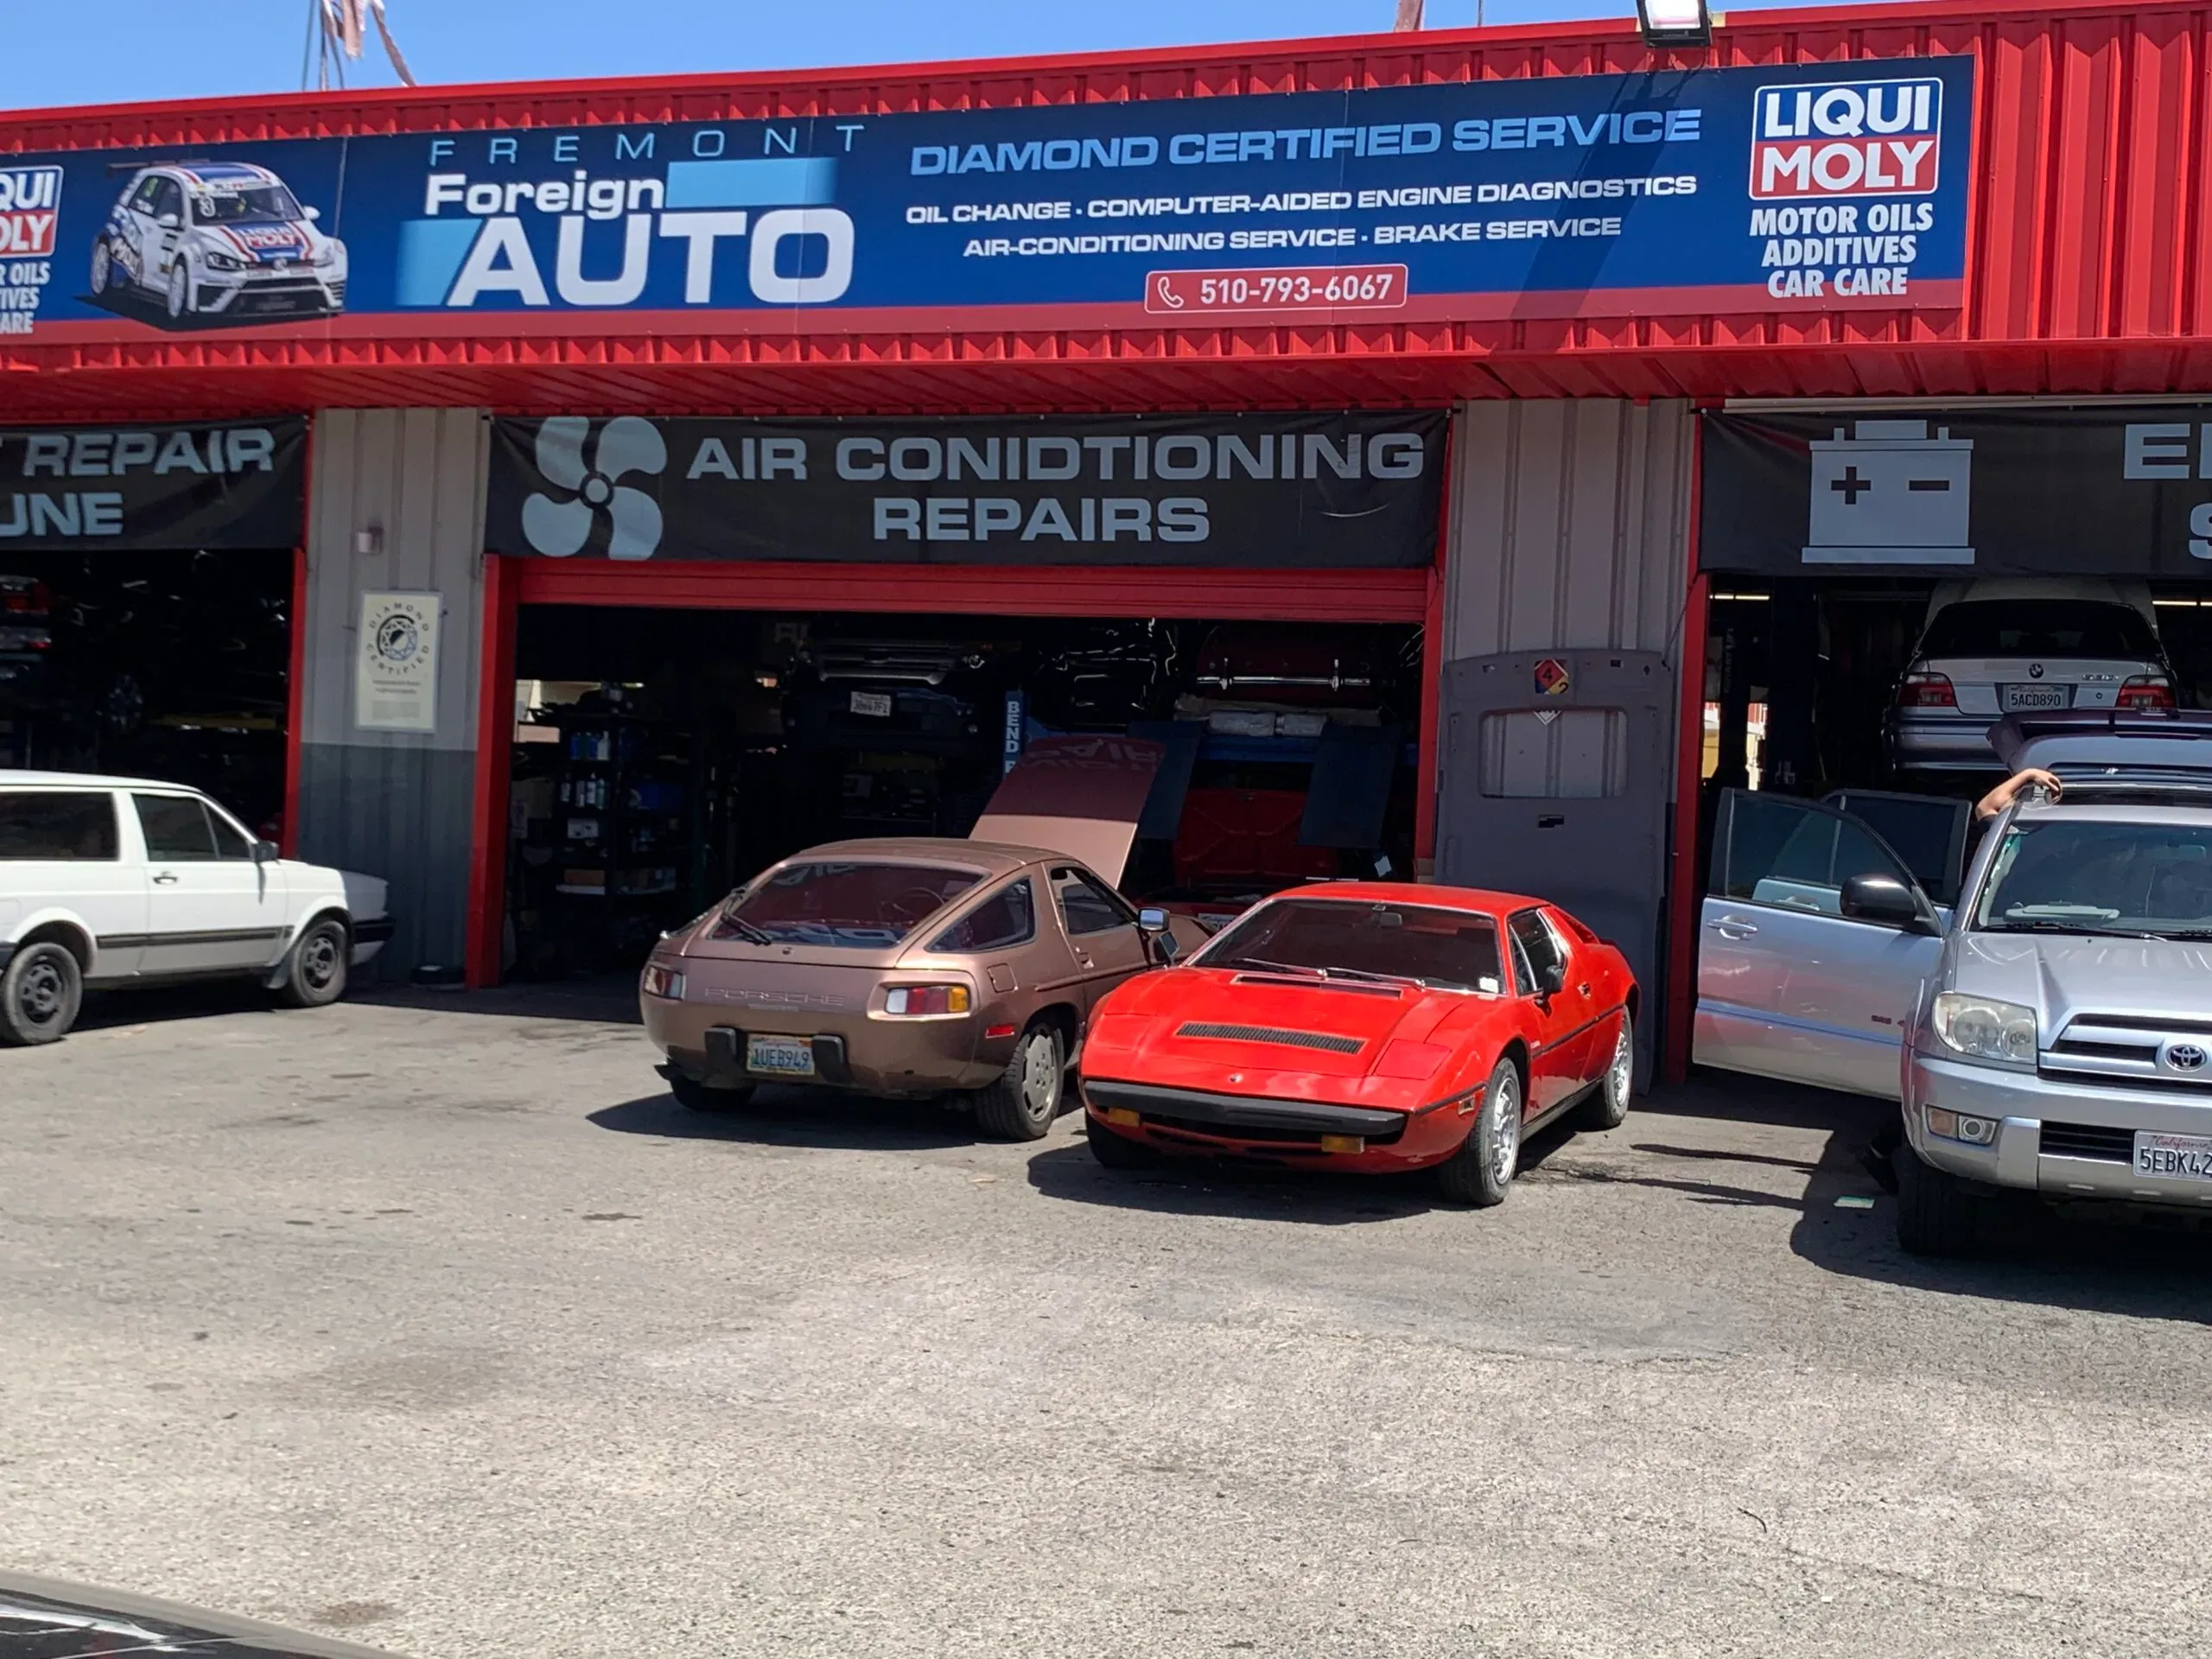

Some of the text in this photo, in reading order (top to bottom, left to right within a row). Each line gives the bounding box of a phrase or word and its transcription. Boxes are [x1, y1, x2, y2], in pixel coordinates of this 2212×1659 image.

[1764, 86, 1931, 138] LIQUI
[430, 124, 865, 165] FREMONT
[911, 109, 1702, 175] DIAMOND CERTIFIED SERVICE
[1761, 140, 1935, 193] MOLY
[424, 170, 664, 220] Foreign
[906, 175, 1698, 225] OIL CHANGE COMPUTER-AIDED ENGINE DIAGNOSTICS
[963, 217, 1622, 257] AIR-CONDITIONING SERVICE BRAKE SERVICE
[1749, 202, 1934, 237] MOTOR OILS
[10, 261, 51, 286] OILS
[446, 208, 856, 307] AUTO
[1761, 235, 1917, 267] ADDITIVES
[1199, 273, 1394, 305] 510-793-6067
[1768, 267, 1909, 299] CAR CARE
[22, 429, 276, 476] REPAIR
[686, 433, 1425, 481] AIR CONIDTIONING
[2123, 423, 2212, 480] E
[874, 497, 1211, 543] REPAIRS
[1006, 701, 1020, 753] BEND
[704, 987, 847, 1007] PORSCHE
